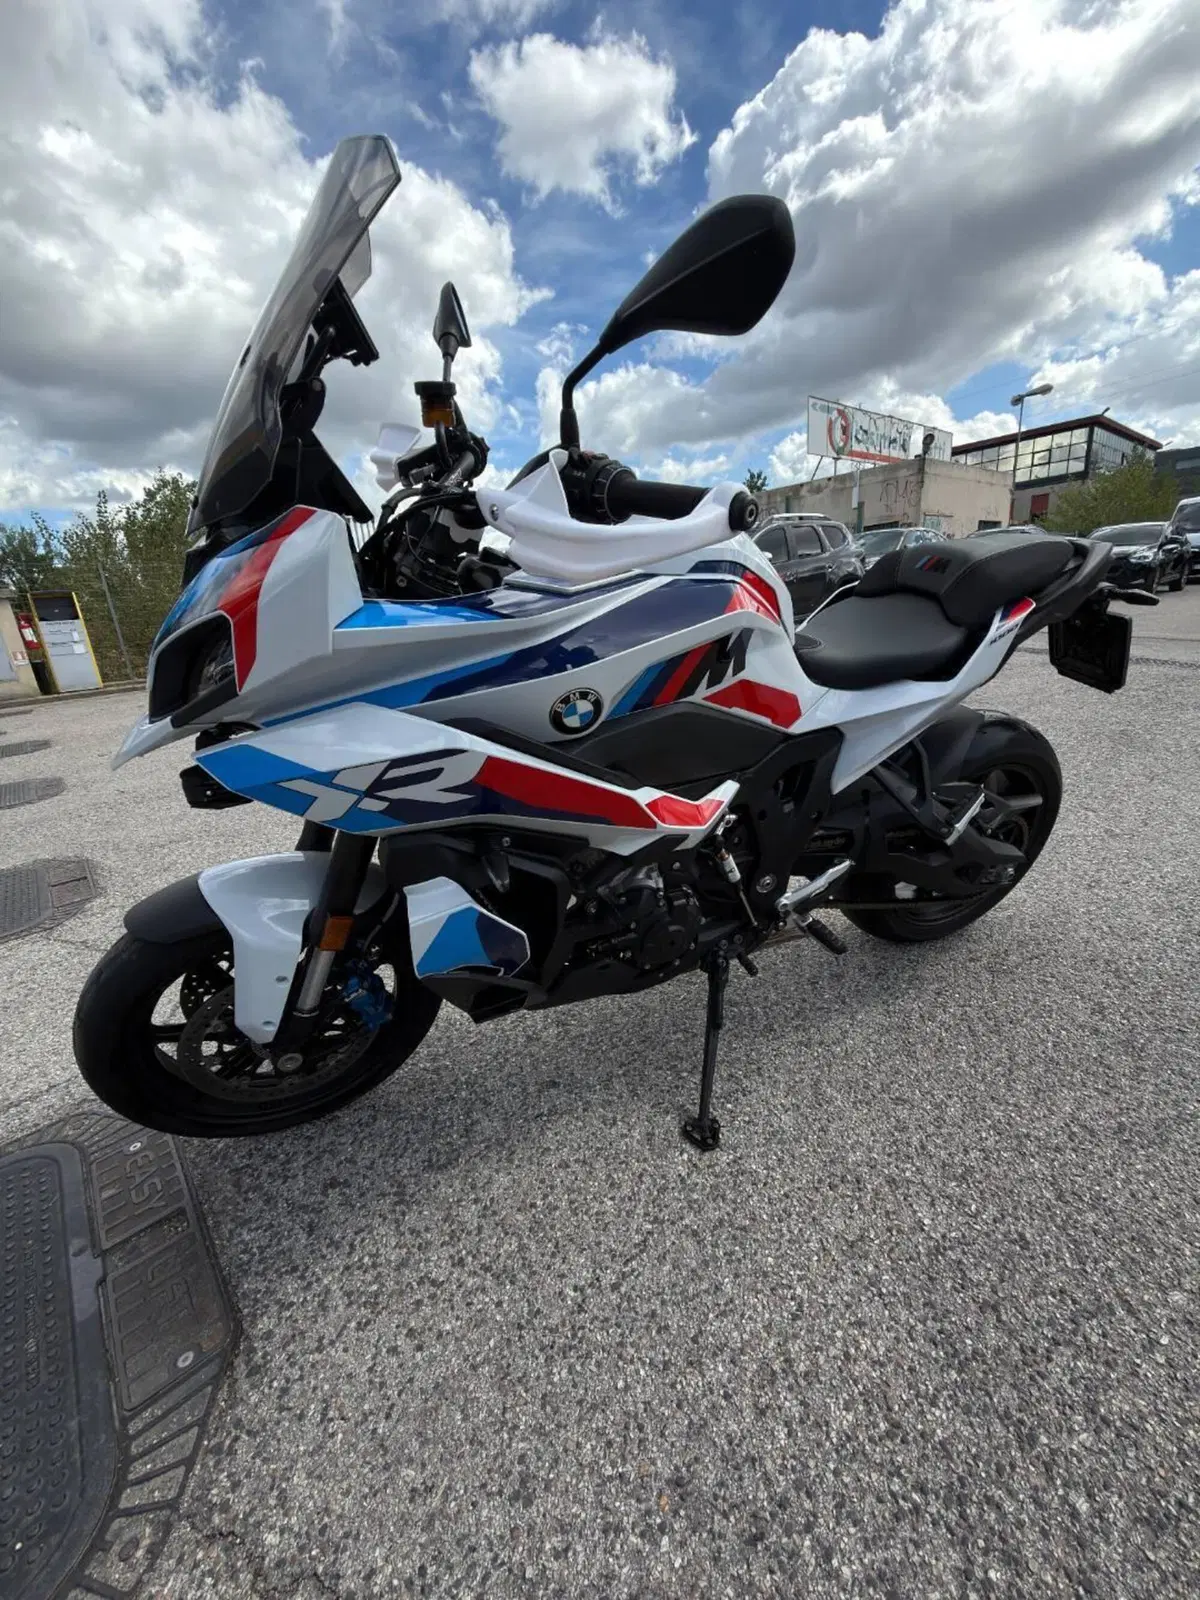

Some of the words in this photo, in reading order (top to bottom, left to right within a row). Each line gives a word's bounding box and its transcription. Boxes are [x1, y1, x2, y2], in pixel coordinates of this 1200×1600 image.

[555, 691, 598, 713] BMW
[276, 749, 489, 822] XR
[126, 1150, 168, 1217] EASY
